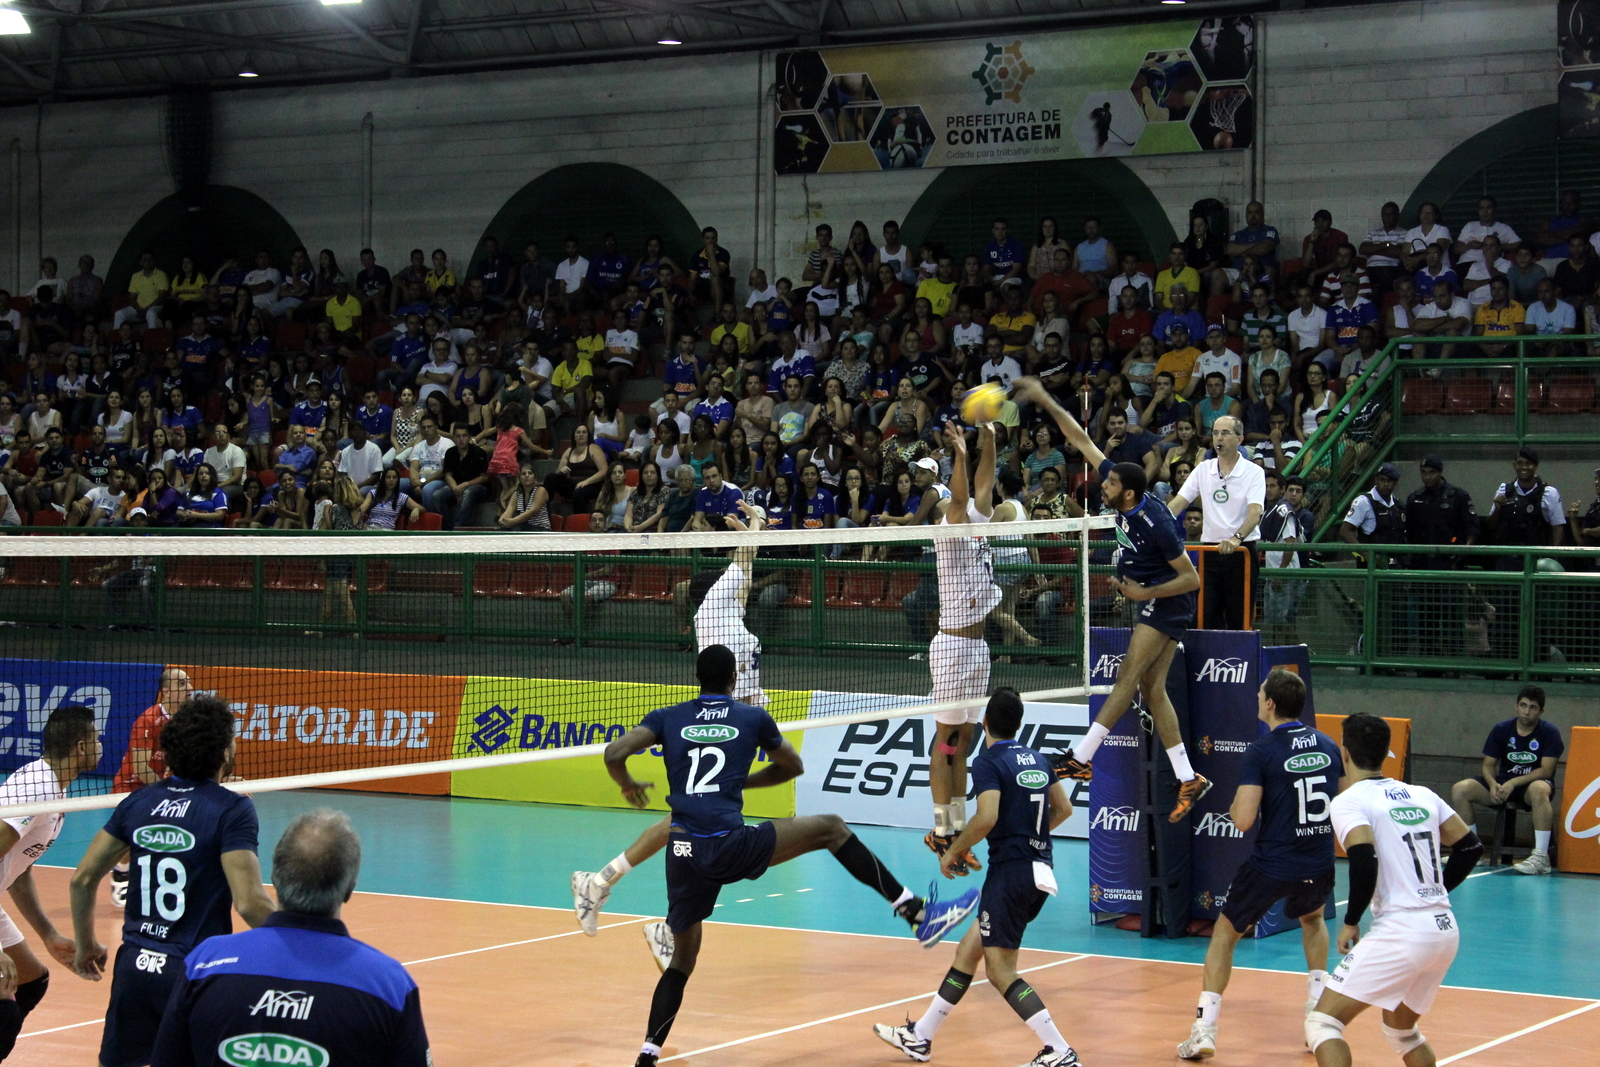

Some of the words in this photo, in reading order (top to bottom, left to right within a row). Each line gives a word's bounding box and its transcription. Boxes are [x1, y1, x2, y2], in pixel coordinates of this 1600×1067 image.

[946, 111, 1036, 128] PREFEITURA
[1041, 109, 1060, 122] DE
[946, 124, 1061, 145] CONTAGEM
[946, 150, 974, 159] Cidade
[976, 149, 994, 159] para
[997, 147, 1031, 157] trabalhar
[1195, 657, 1249, 683] Amil
[695, 707, 729, 720] Amil
[230, 702, 435, 749] GATORADE
[687, 728, 730, 738] SADA
[1291, 734, 1317, 750] Amil
[686, 746, 726, 795] 12
[1290, 756, 1325, 769] SADA
[1021, 774, 1046, 784] SADA
[151, 799, 191, 818] Amil
[1294, 775, 1330, 824] 15
[1030, 793, 1045, 835] 7
[1089, 806, 1140, 832] Amil
[1391, 809, 1426, 821] SADA
[140, 829, 186, 847] SADA
[1295, 824, 1332, 837] WINTERS
[1402, 831, 1439, 884] 17
[137, 854, 187, 922] 18
[140, 922, 169, 938] FILIPE
[249, 990, 314, 1020] Amil
[232, 1041, 313, 1066] SADA
